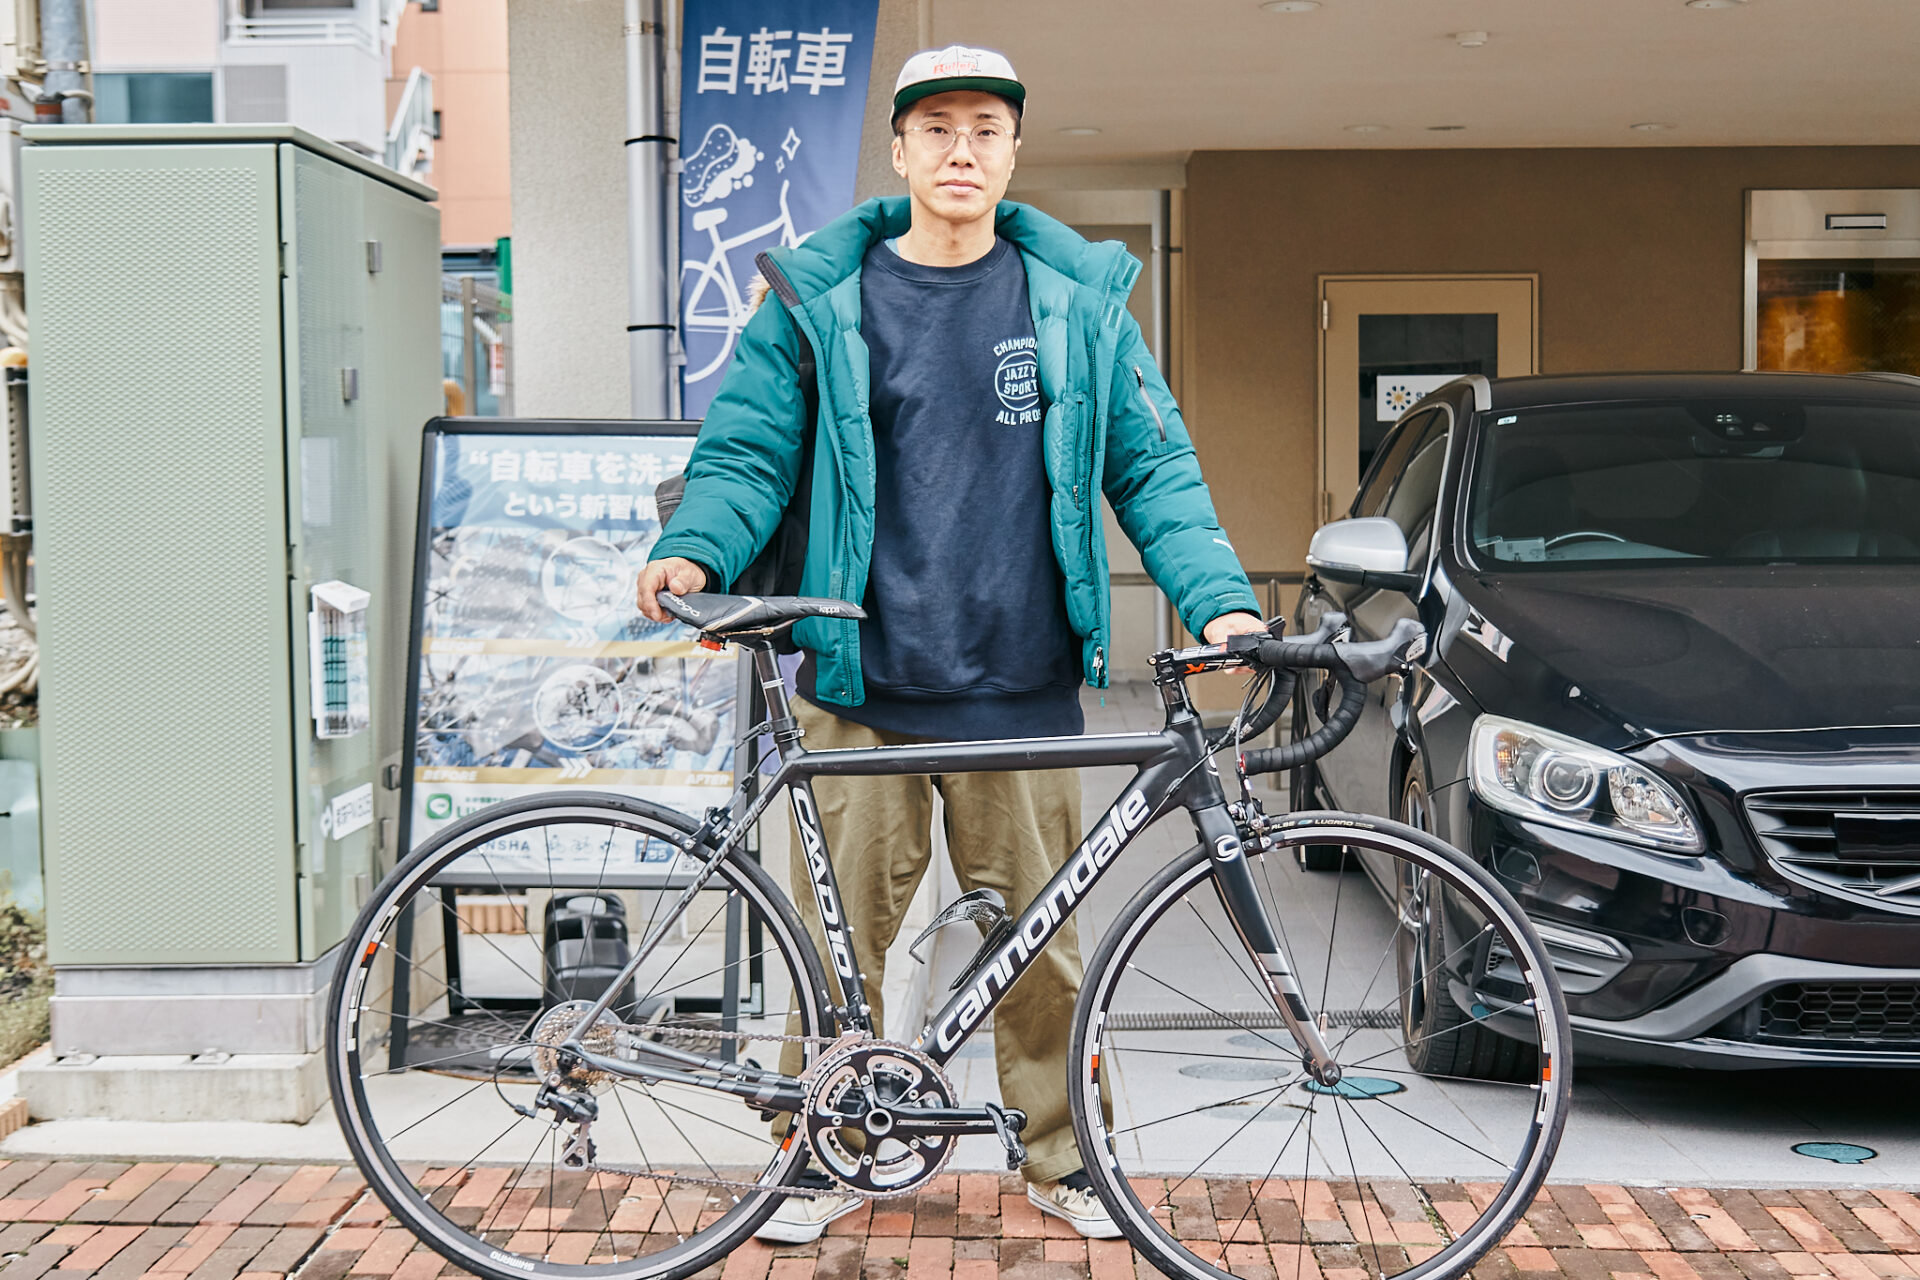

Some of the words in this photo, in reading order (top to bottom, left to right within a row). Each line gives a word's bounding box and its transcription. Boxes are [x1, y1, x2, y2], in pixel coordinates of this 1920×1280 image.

[697, 26, 853, 95] 自転車
[993, 337, 1038, 357] CHAMPIO
[1004, 365, 1037, 381] JAZZY
[995, 410, 1017, 426] ALL
[423, 769, 478, 781] BEFORE
[685, 774, 730, 785] AFTER
[1314, 818, 1354, 827] LUGANO
[793, 787, 853, 979] CAAD10
[936, 788, 1150, 1053] cannondale
